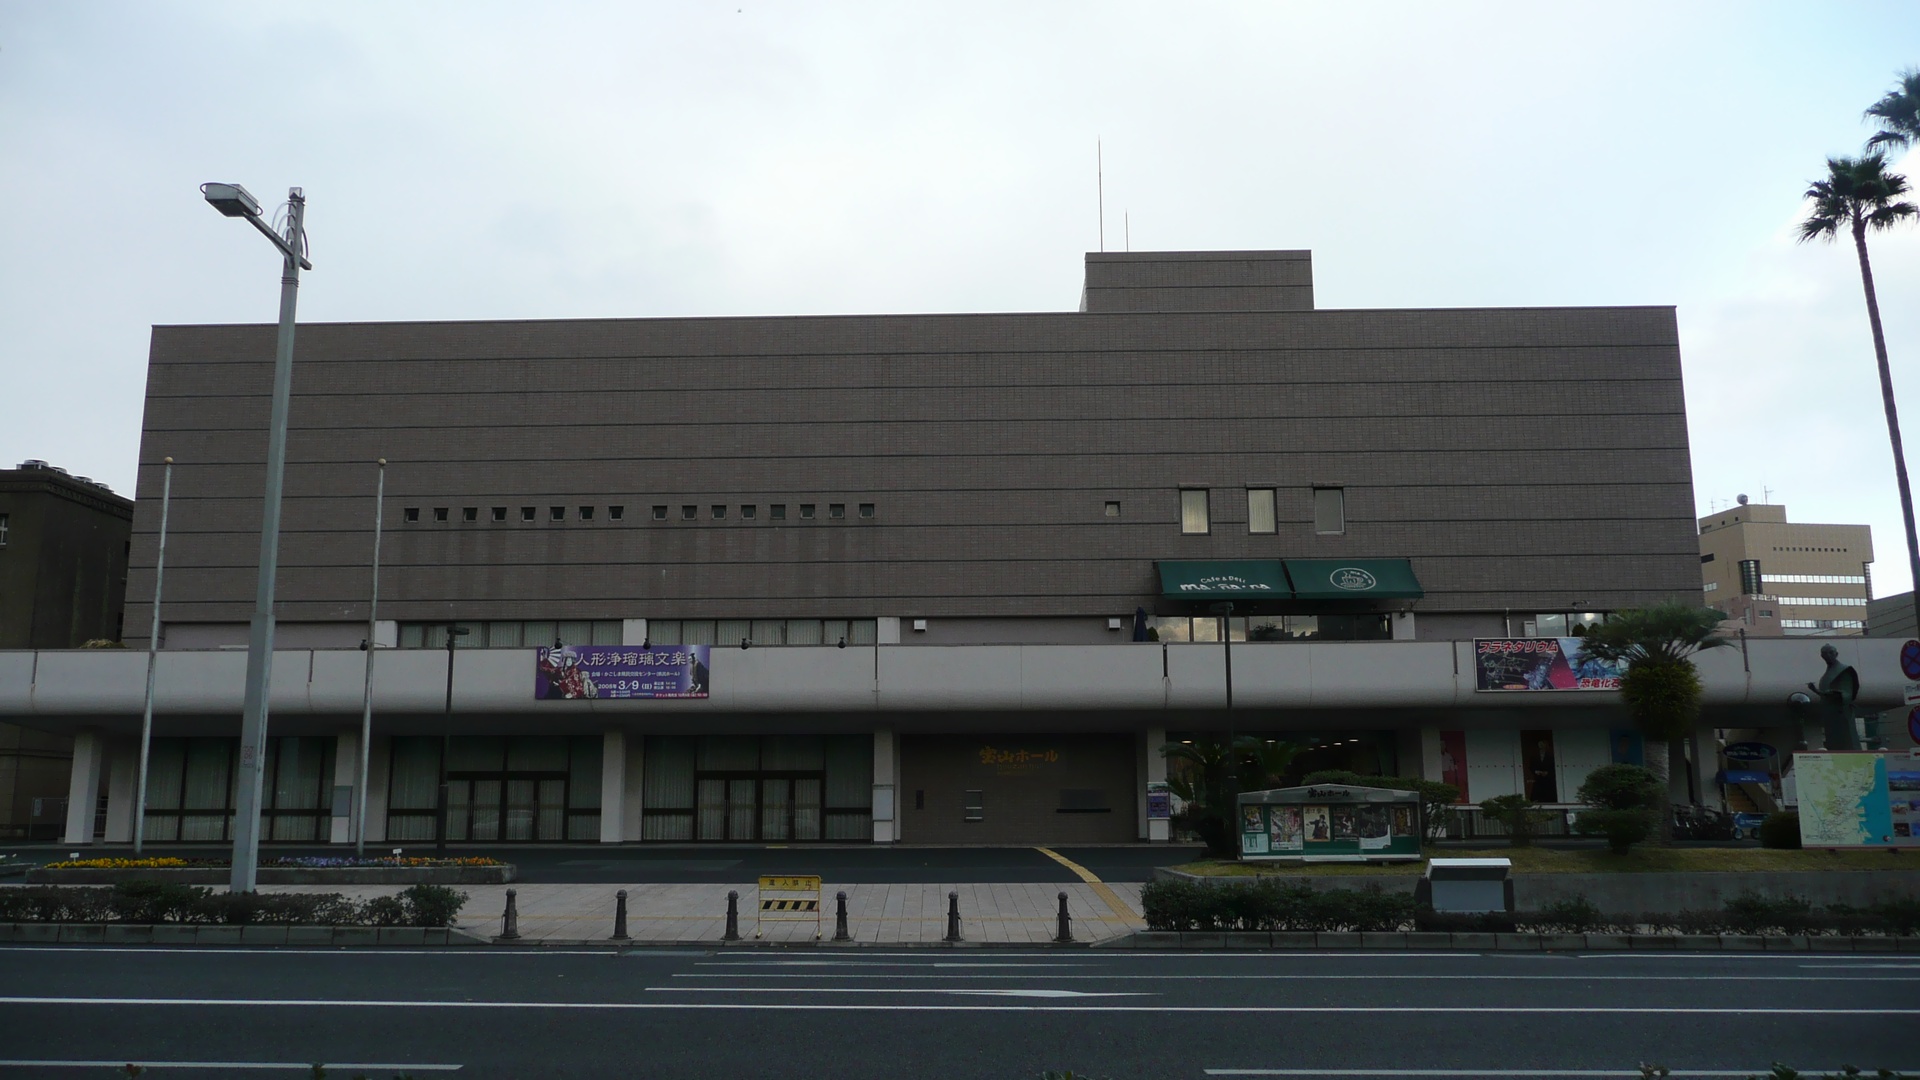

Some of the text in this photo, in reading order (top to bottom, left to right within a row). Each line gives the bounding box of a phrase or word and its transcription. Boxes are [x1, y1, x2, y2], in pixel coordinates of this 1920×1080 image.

[1479, 641, 1559, 653] プラネタリウム
[575, 651, 687, 666] 人形浄瑠璃文楽
